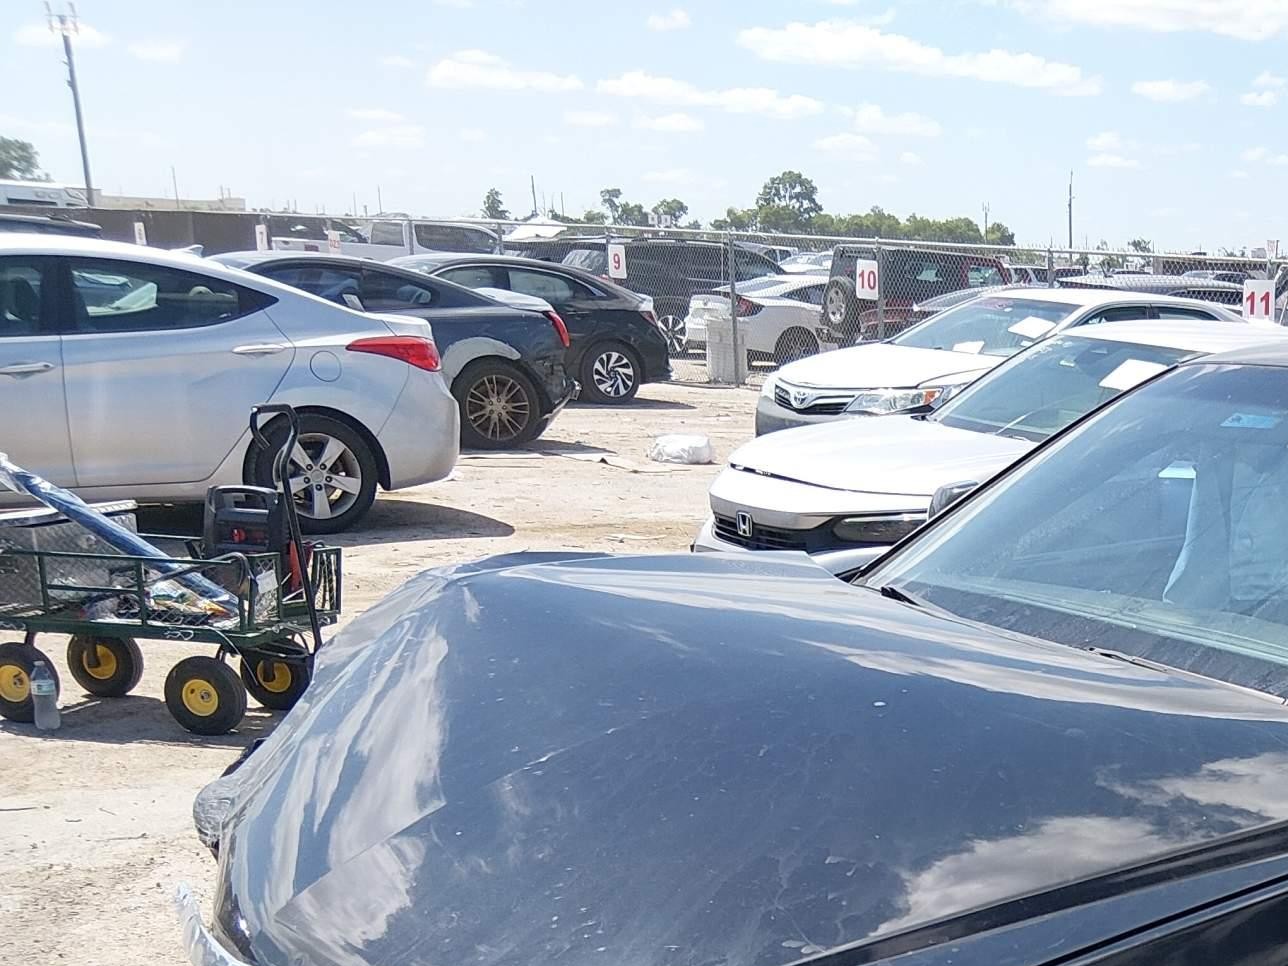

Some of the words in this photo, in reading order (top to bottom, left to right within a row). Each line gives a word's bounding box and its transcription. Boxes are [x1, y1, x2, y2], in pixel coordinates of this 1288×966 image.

[612, 253, 621, 270] 9
[858, 270, 877, 291] 10
[1245, 291, 1271, 316] 11
